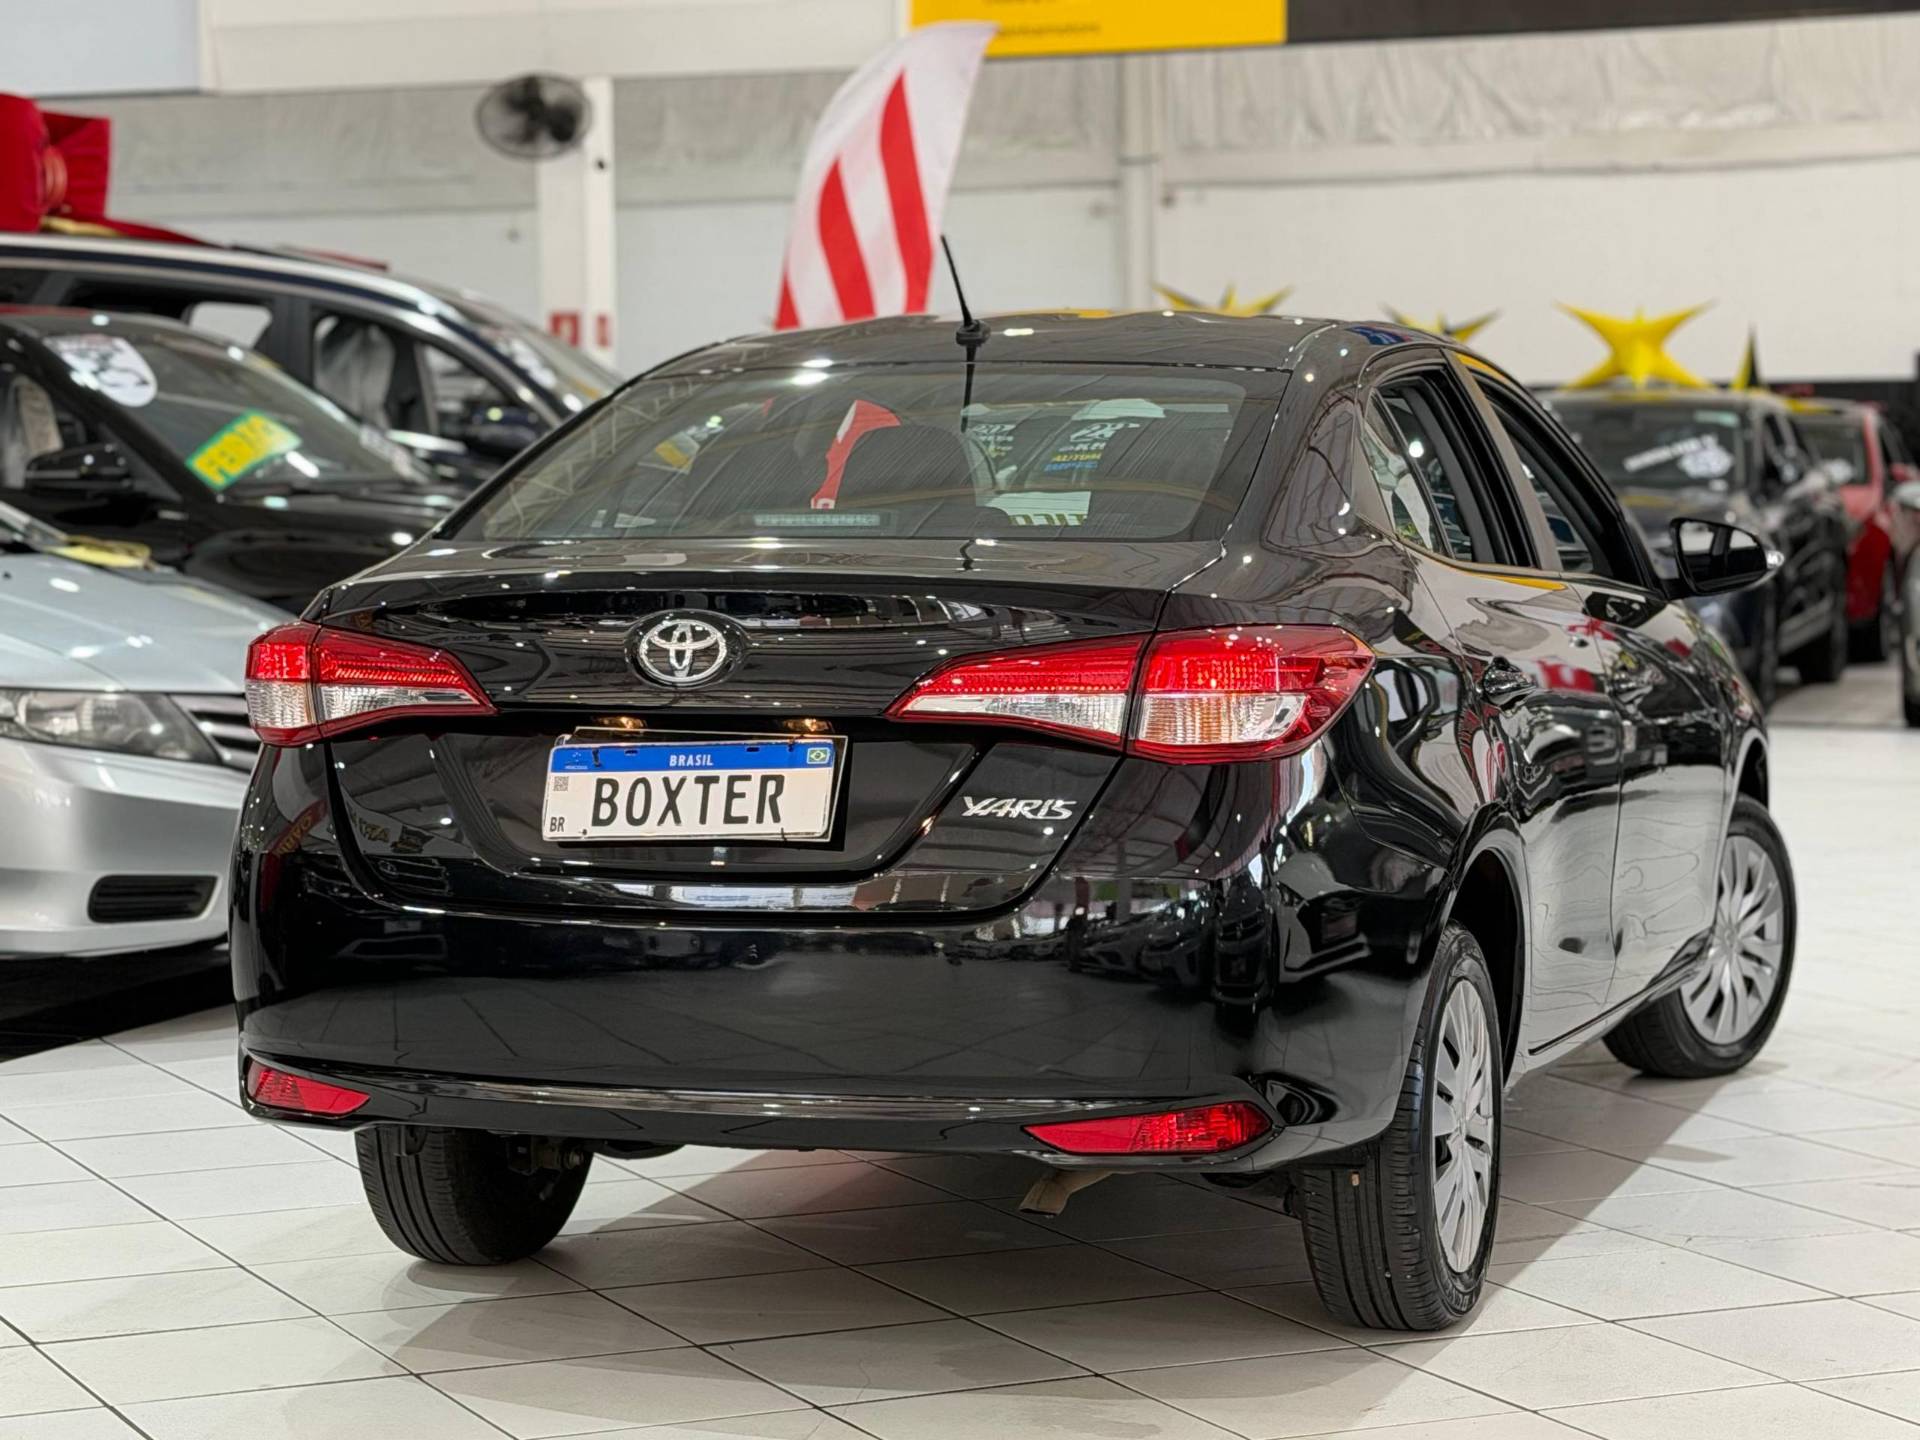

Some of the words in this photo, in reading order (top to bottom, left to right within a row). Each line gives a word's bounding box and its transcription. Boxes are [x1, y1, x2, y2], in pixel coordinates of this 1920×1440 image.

[669, 754, 713, 767] BRASIL
[591, 775, 786, 827] BOXTER
[961, 796, 1077, 820] YARIS
[549, 816, 565, 833] BR
